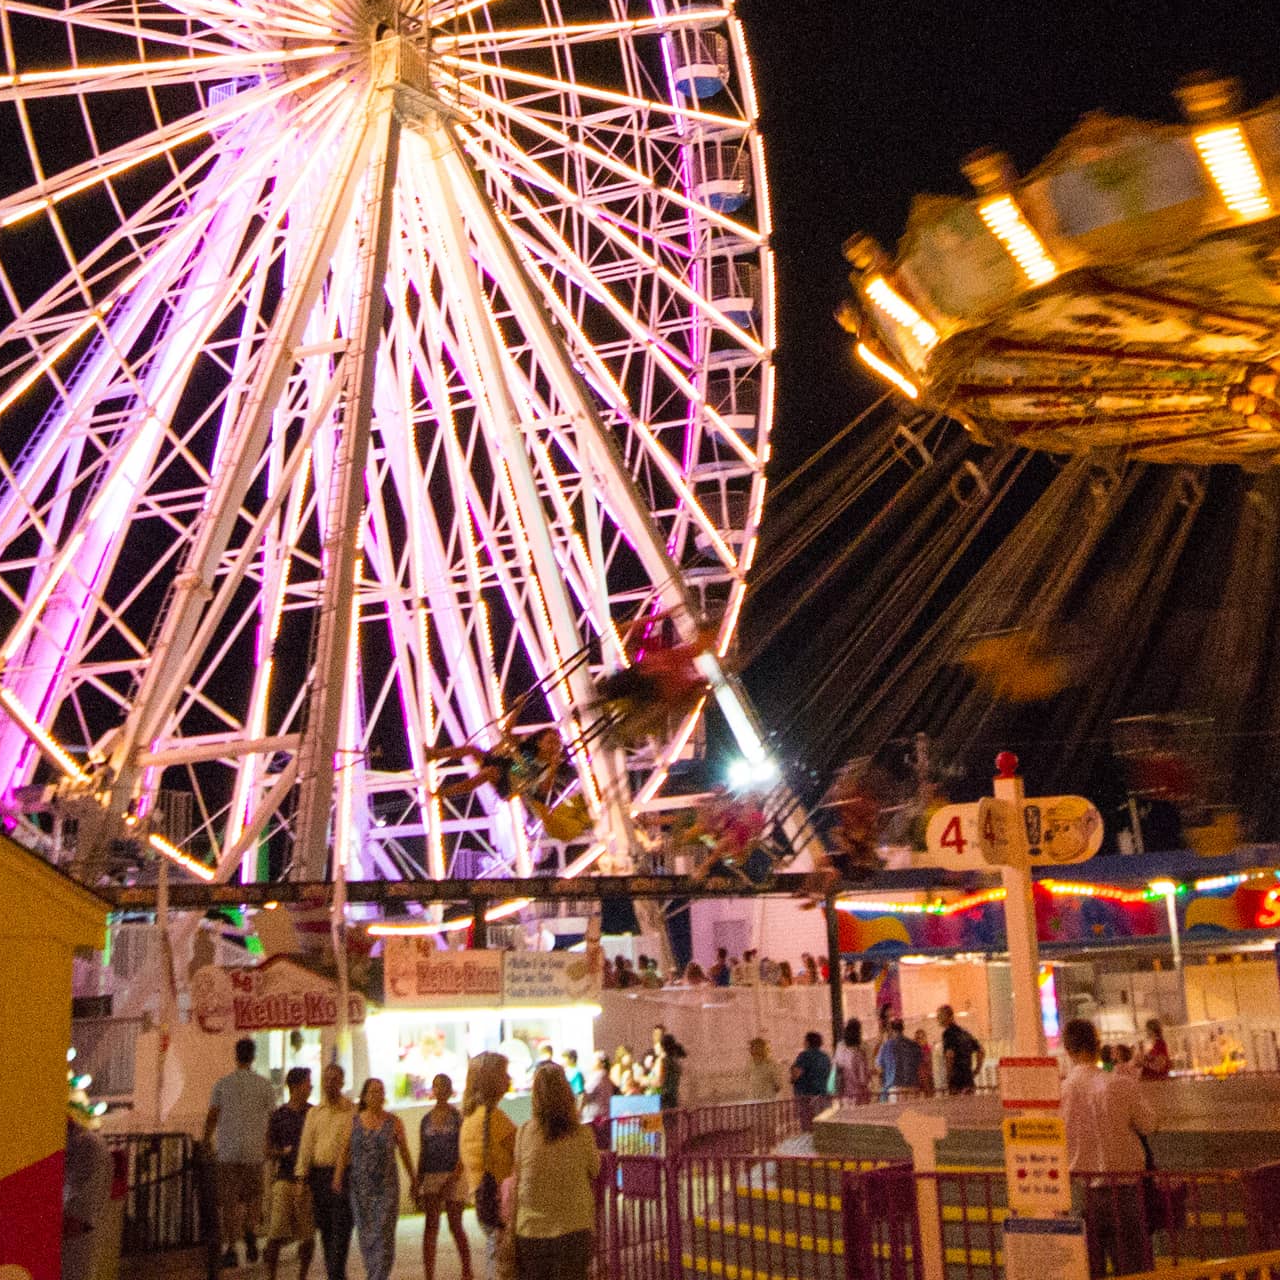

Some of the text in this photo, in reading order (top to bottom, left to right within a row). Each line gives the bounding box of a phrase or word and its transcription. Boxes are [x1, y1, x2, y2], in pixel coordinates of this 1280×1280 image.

[940, 815, 968, 855] 4
[234, 990, 366, 1030] Kettle Kon
